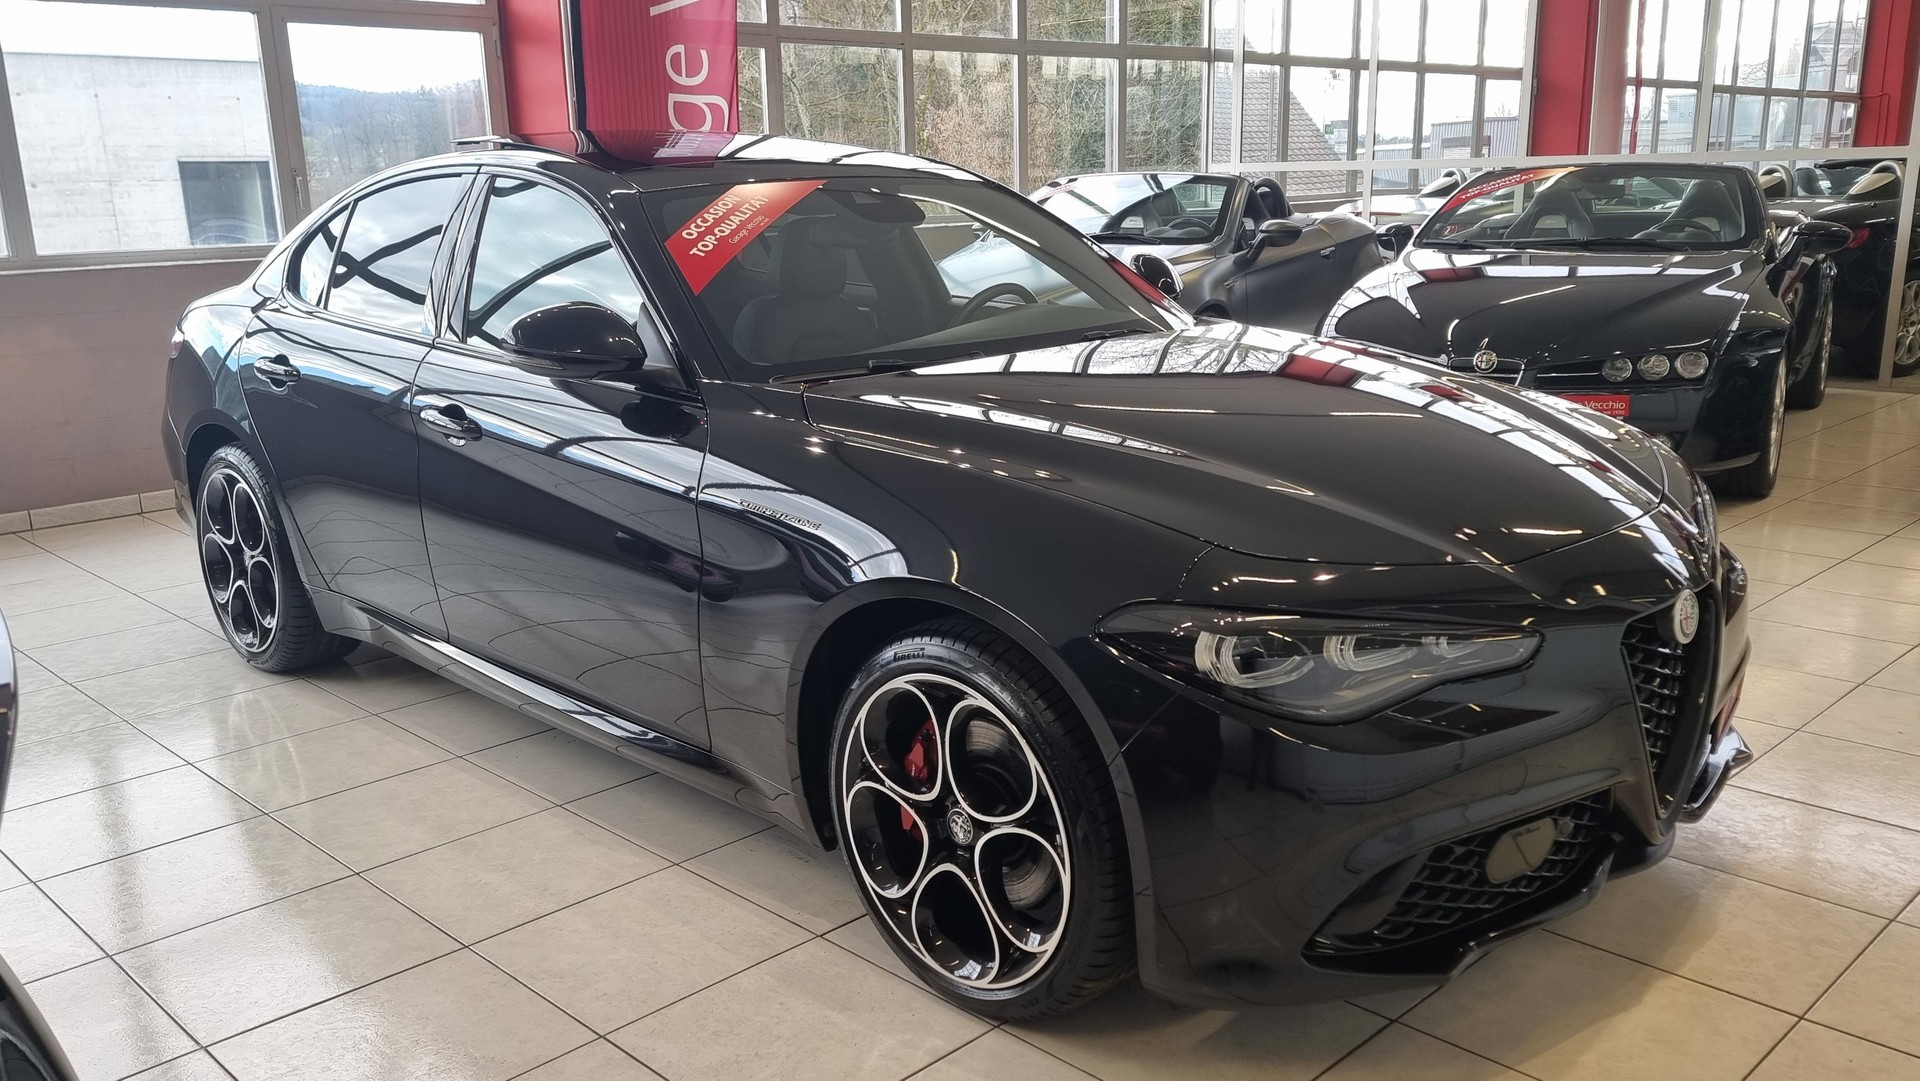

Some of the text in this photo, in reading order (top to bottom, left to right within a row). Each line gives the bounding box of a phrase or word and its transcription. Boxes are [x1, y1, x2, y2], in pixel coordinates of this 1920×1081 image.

[682, 194, 741, 240] OCCASION
[1585, 400, 1626, 409] Vecchio
[893, 647, 926, 662] PIRELLI
